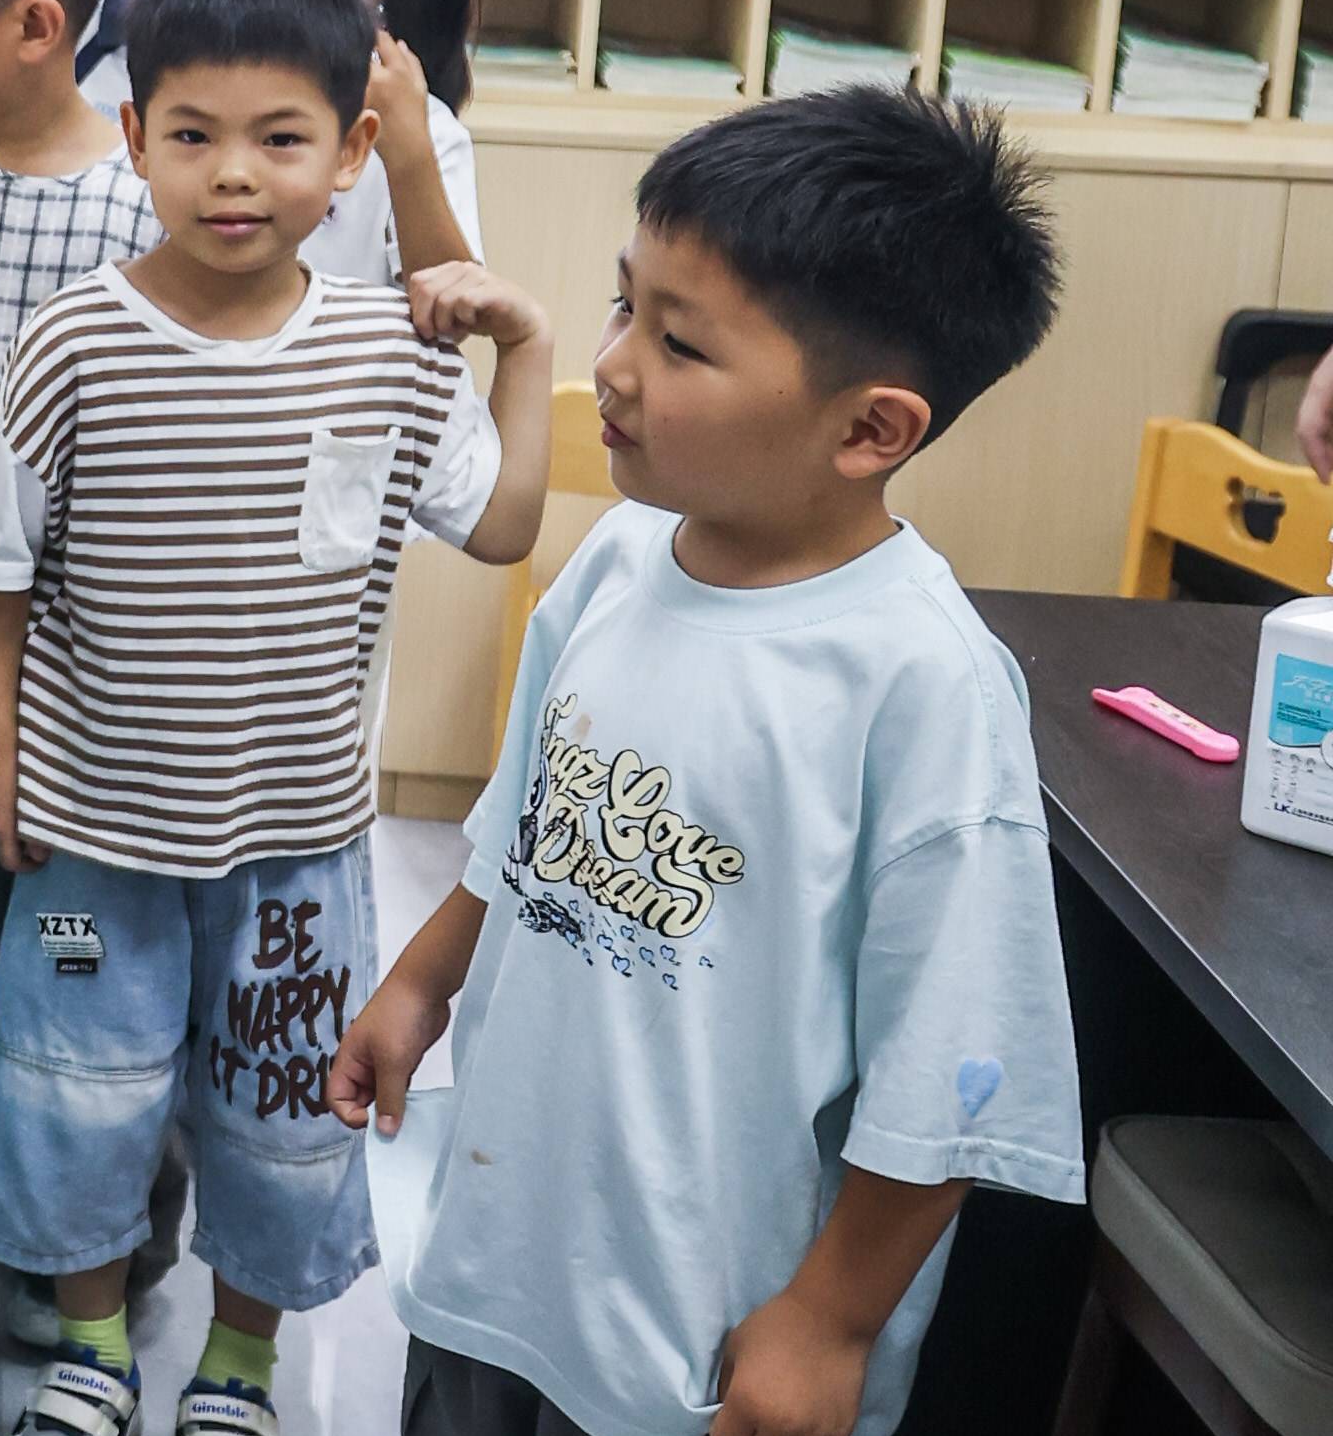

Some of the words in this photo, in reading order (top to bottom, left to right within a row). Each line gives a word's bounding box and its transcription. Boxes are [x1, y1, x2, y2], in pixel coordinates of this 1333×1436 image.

[38, 916, 97, 937] XZTX
[252, 899, 322, 973] BE
[227, 966, 345, 1056] HAPPY
